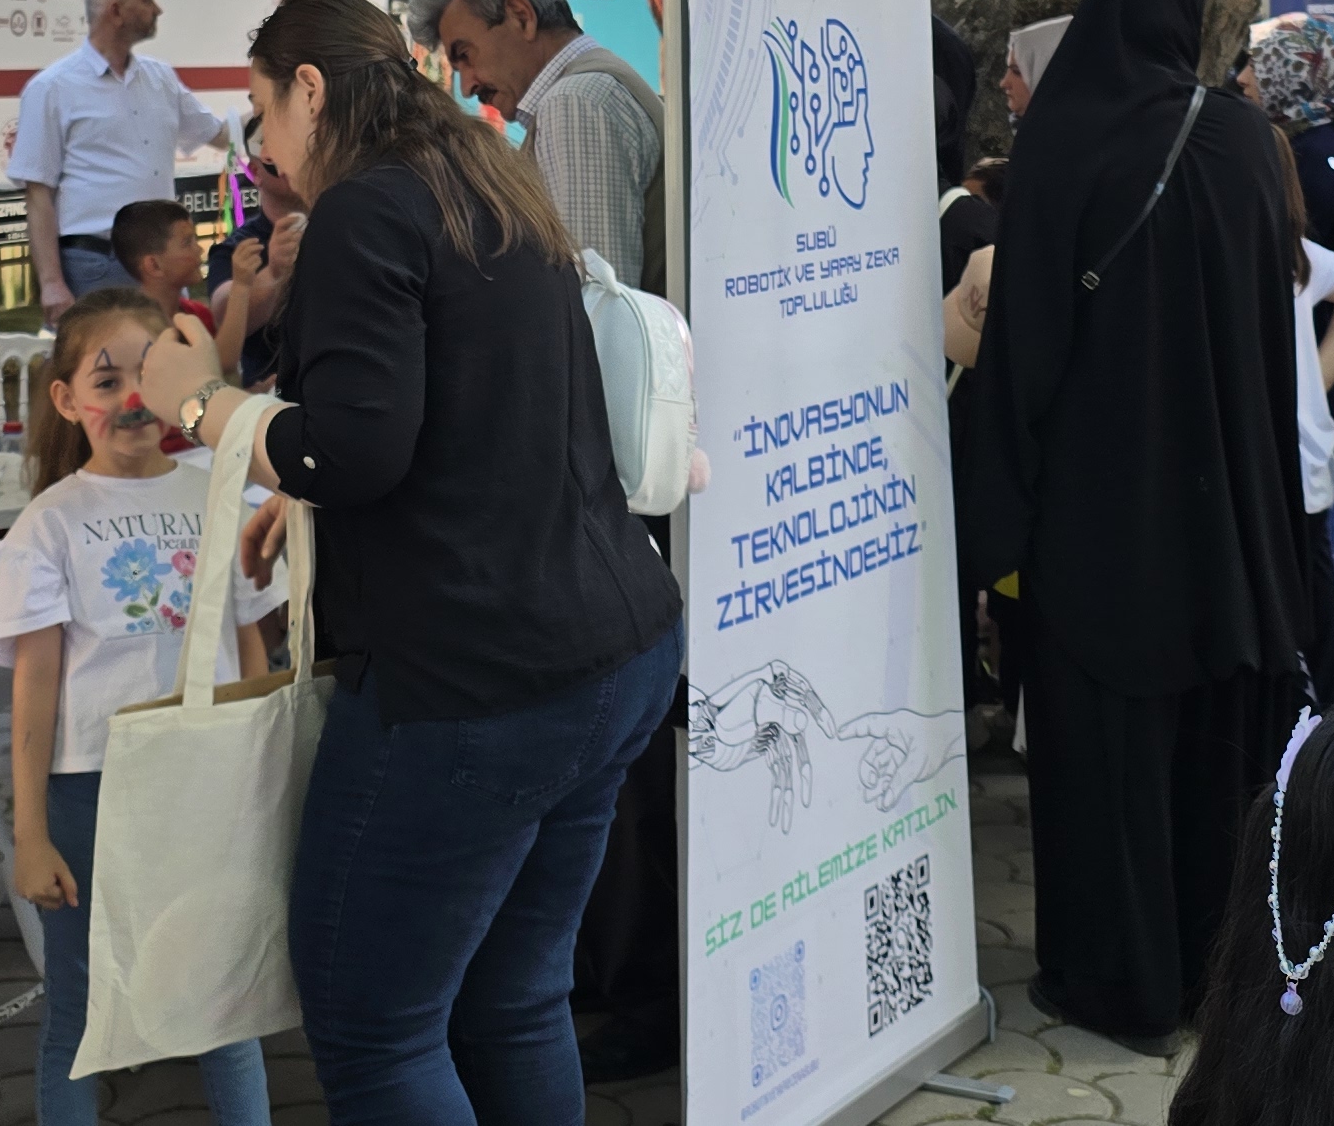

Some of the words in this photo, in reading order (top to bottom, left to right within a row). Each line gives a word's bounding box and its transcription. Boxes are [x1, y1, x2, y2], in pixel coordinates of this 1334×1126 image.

[796, 225, 837, 253] SUBÜ
[725, 265, 791, 299] ROBOTİK
[795, 263, 815, 283] VE
[820, 254, 862, 279] YAPAY
[779, 282, 858, 319] TOPLULUĞU
[766, 435, 889, 507] KALBİNDE,
[731, 474, 917, 569] TEKNOLOJİNİN
[705, 910, 743, 957] SİZ
[750, 891, 777, 930] DE
[782, 834, 877, 912] AİLEMİZE
[882, 788, 958, 853] KATILIN
